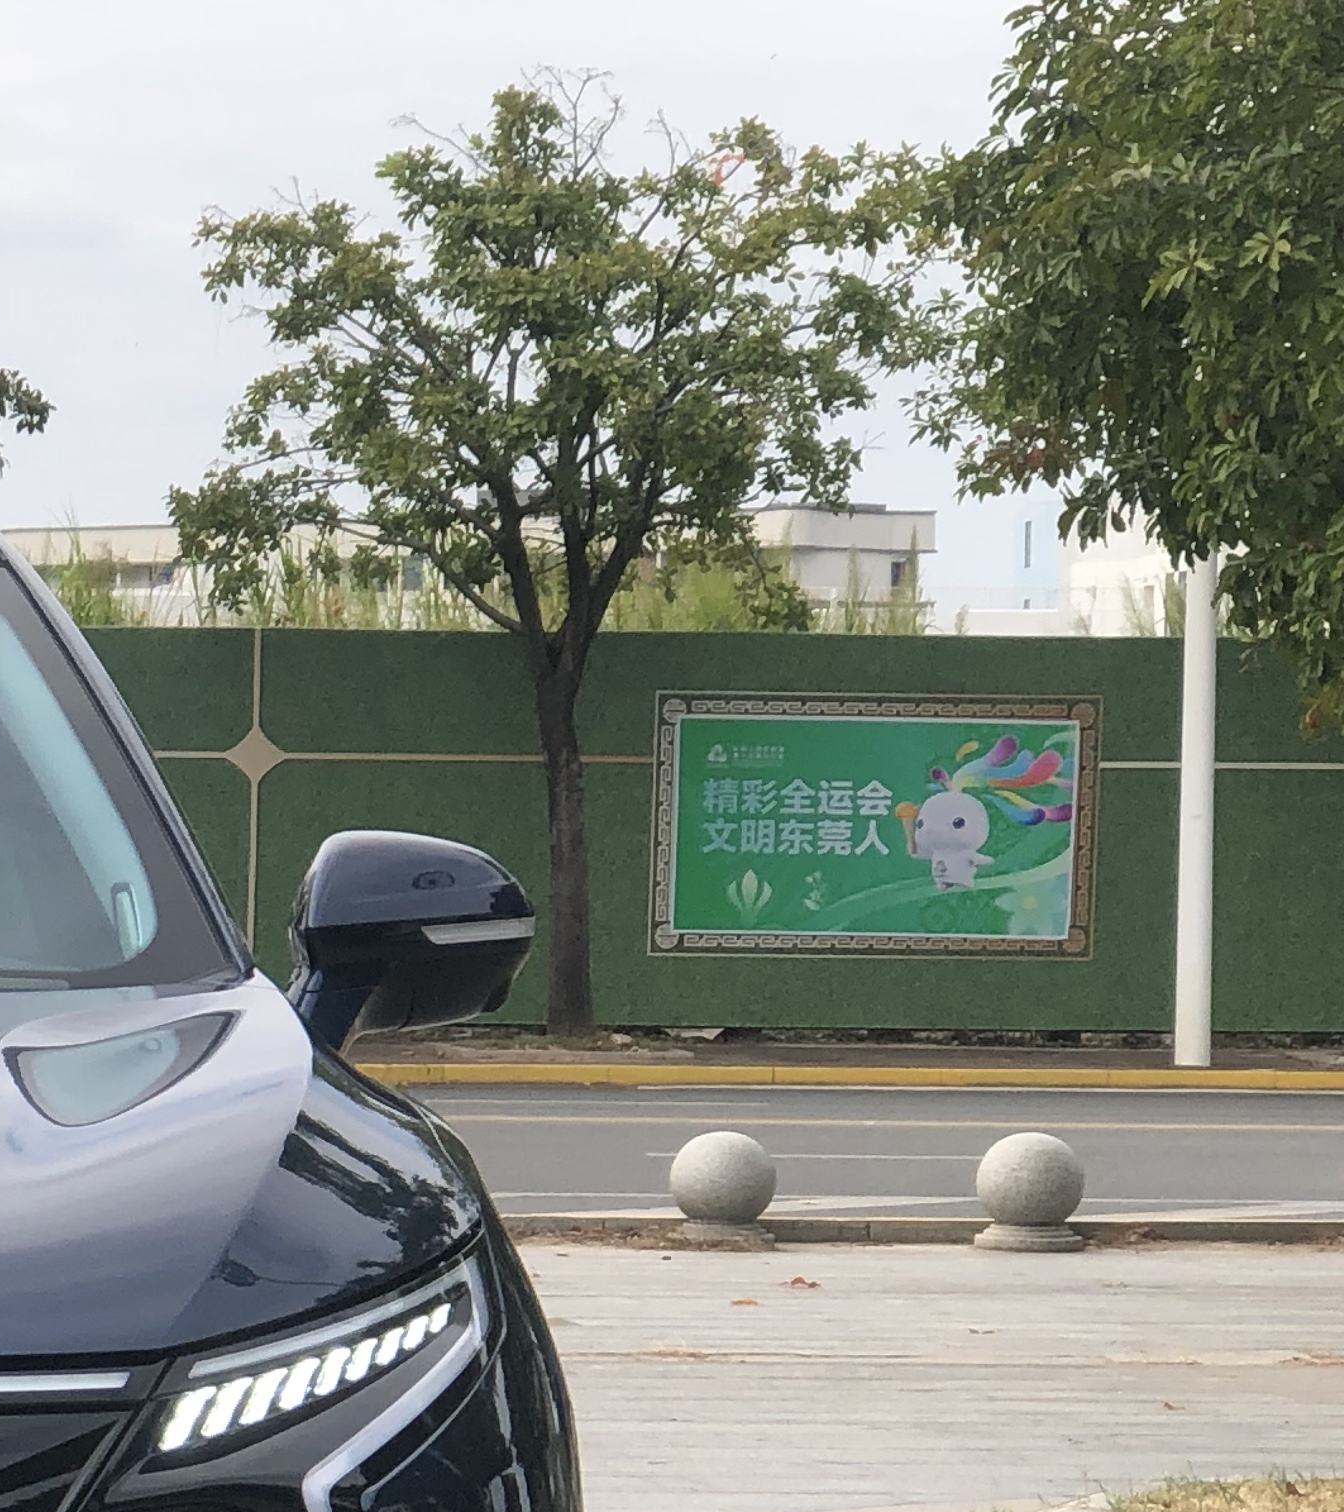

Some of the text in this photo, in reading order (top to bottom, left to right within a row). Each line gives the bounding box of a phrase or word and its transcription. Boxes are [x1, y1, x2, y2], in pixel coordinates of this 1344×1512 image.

[703, 778, 893, 816] 精彩全运会
[701, 818, 890, 856] 文明东莞人
